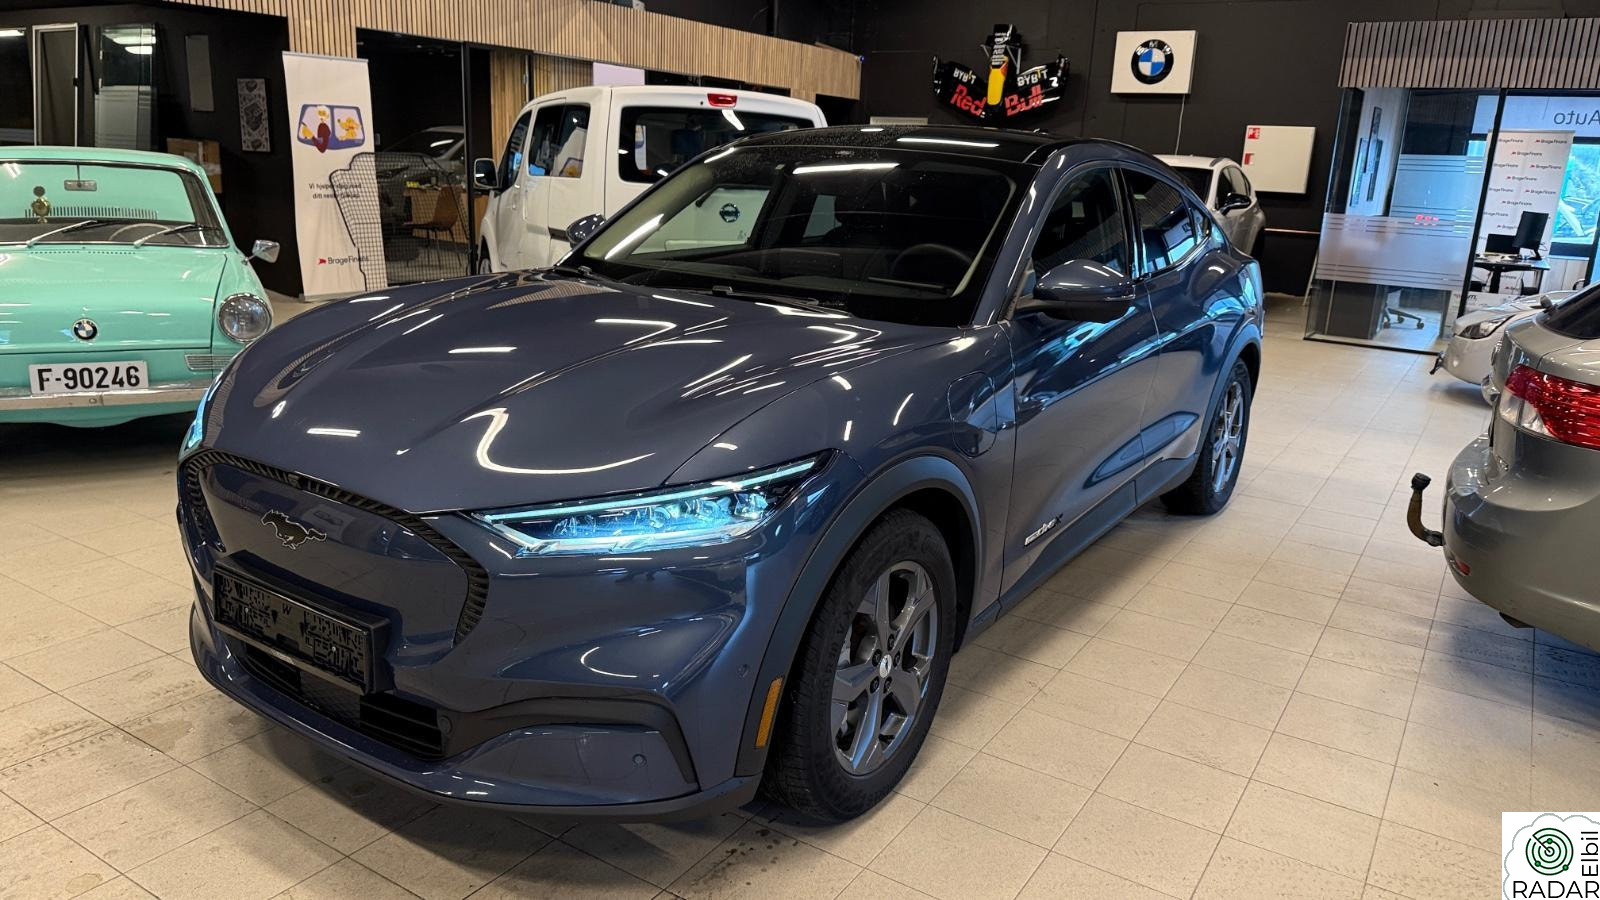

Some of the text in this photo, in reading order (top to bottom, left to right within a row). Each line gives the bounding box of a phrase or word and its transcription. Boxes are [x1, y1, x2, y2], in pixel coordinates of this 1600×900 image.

[950, 84, 1043, 116] Red Bull
[37, 365, 141, 392] F-90246
